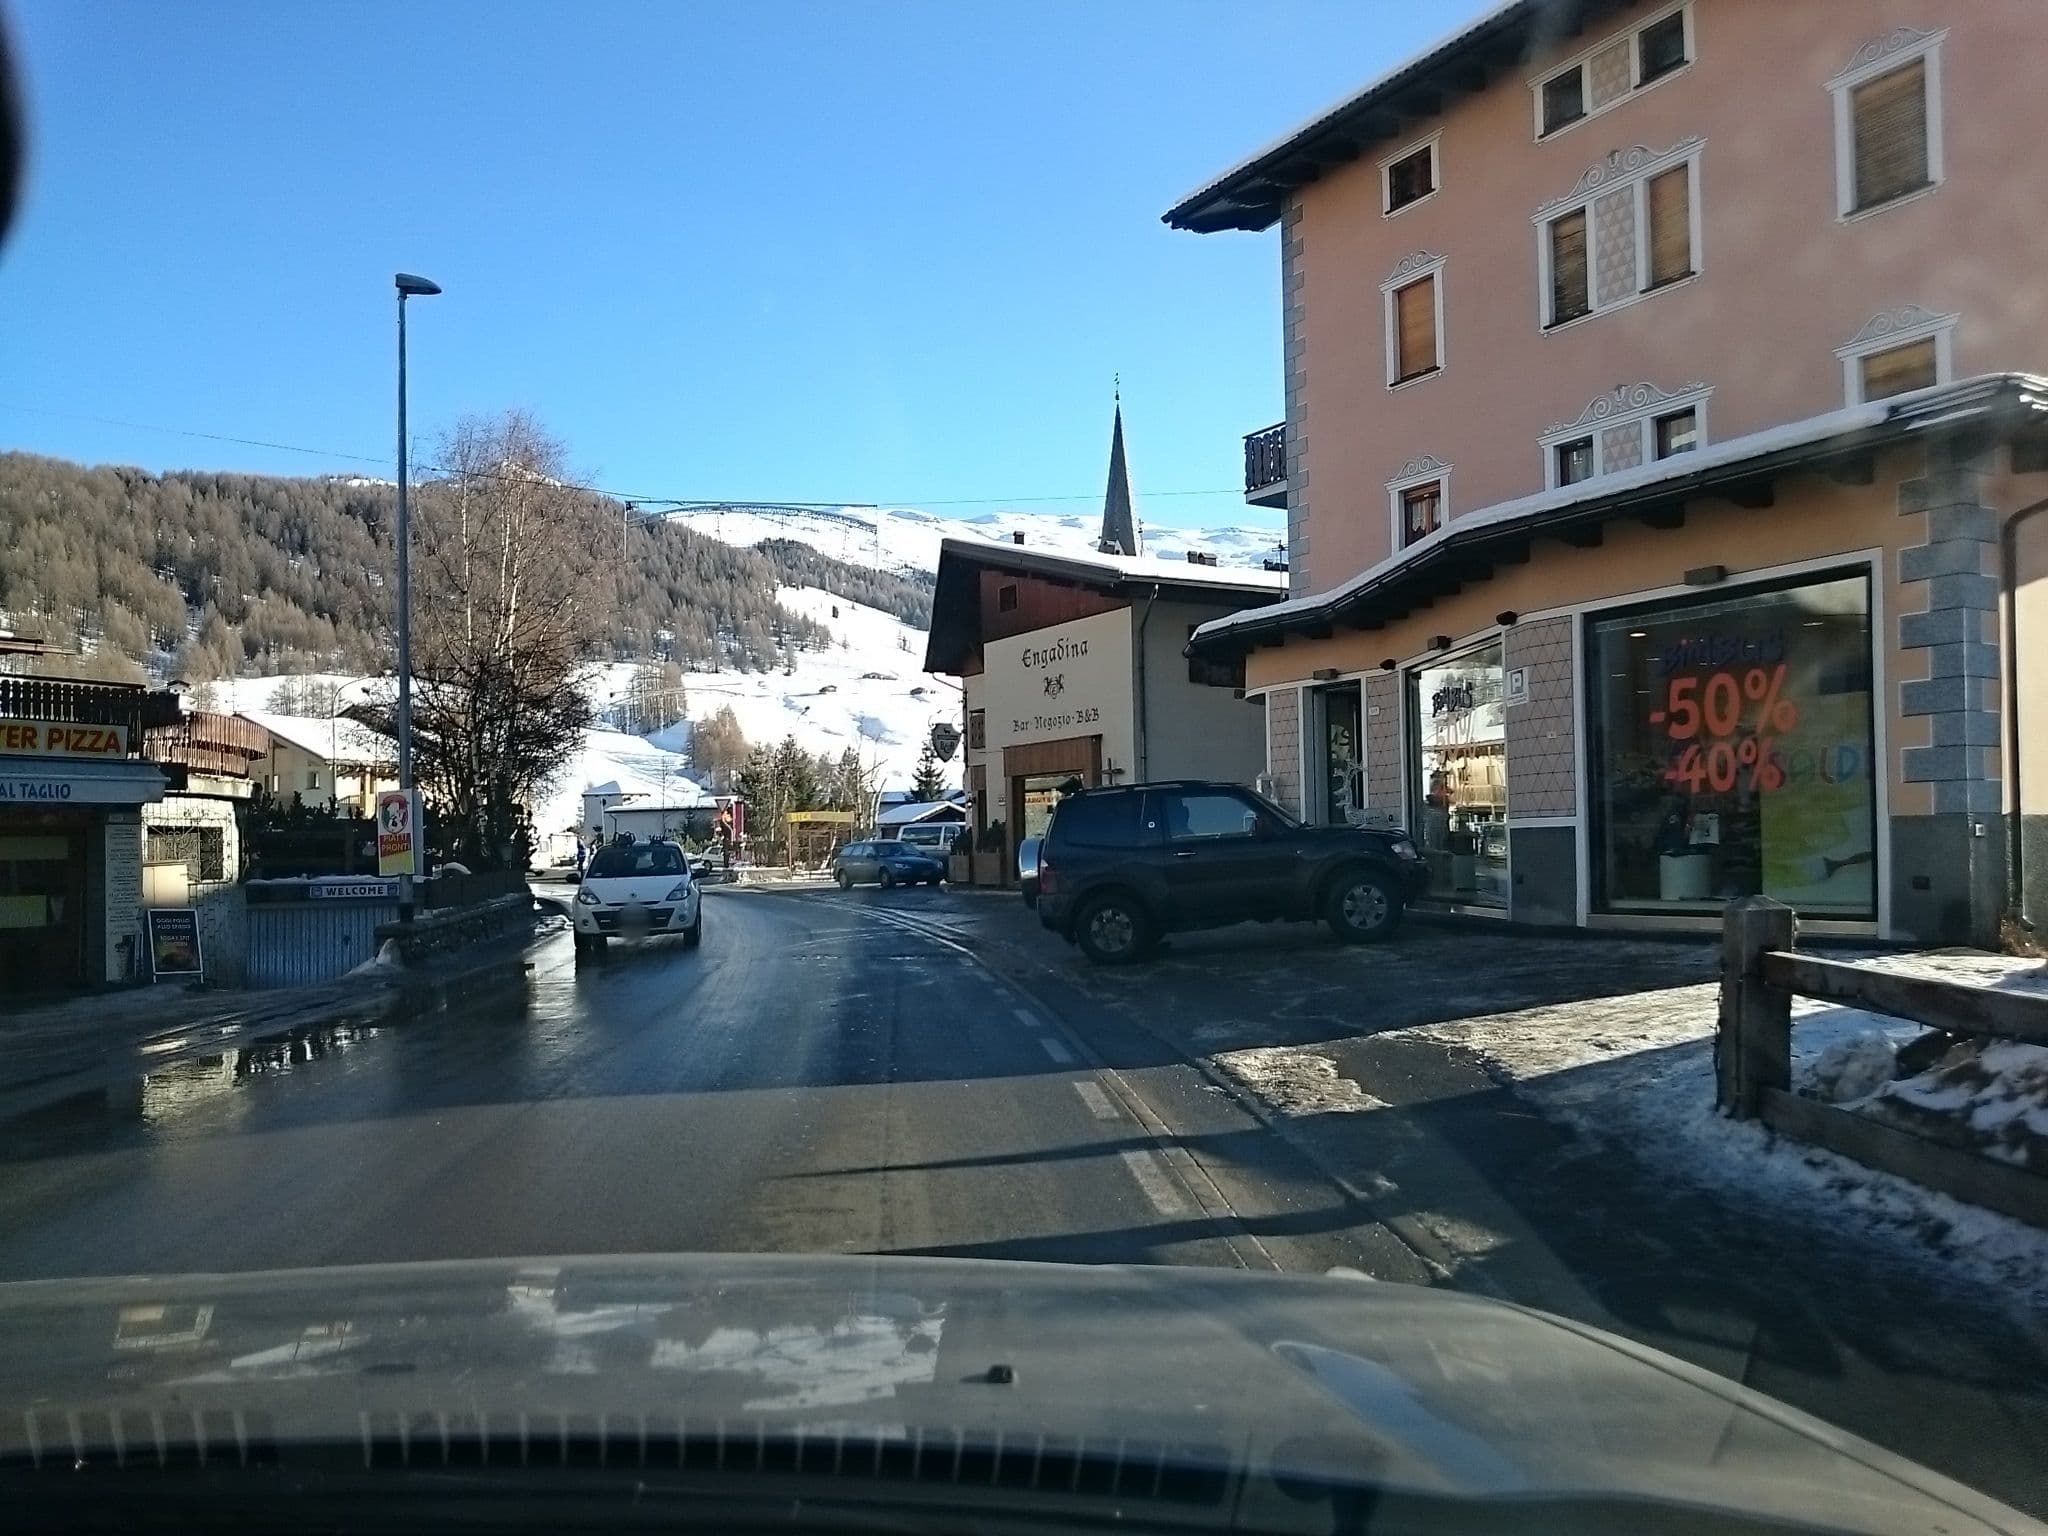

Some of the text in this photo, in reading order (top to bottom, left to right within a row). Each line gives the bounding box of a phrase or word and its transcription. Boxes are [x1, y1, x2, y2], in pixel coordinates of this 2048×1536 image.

[1021, 637, 1088, 669] Engadina
[1650, 664, 1798, 740] -50%
[47, 728, 121, 753] PIZZA
[19, 783, 72, 799] TAGLIO
[326, 886, 384, 896] WELCOME
